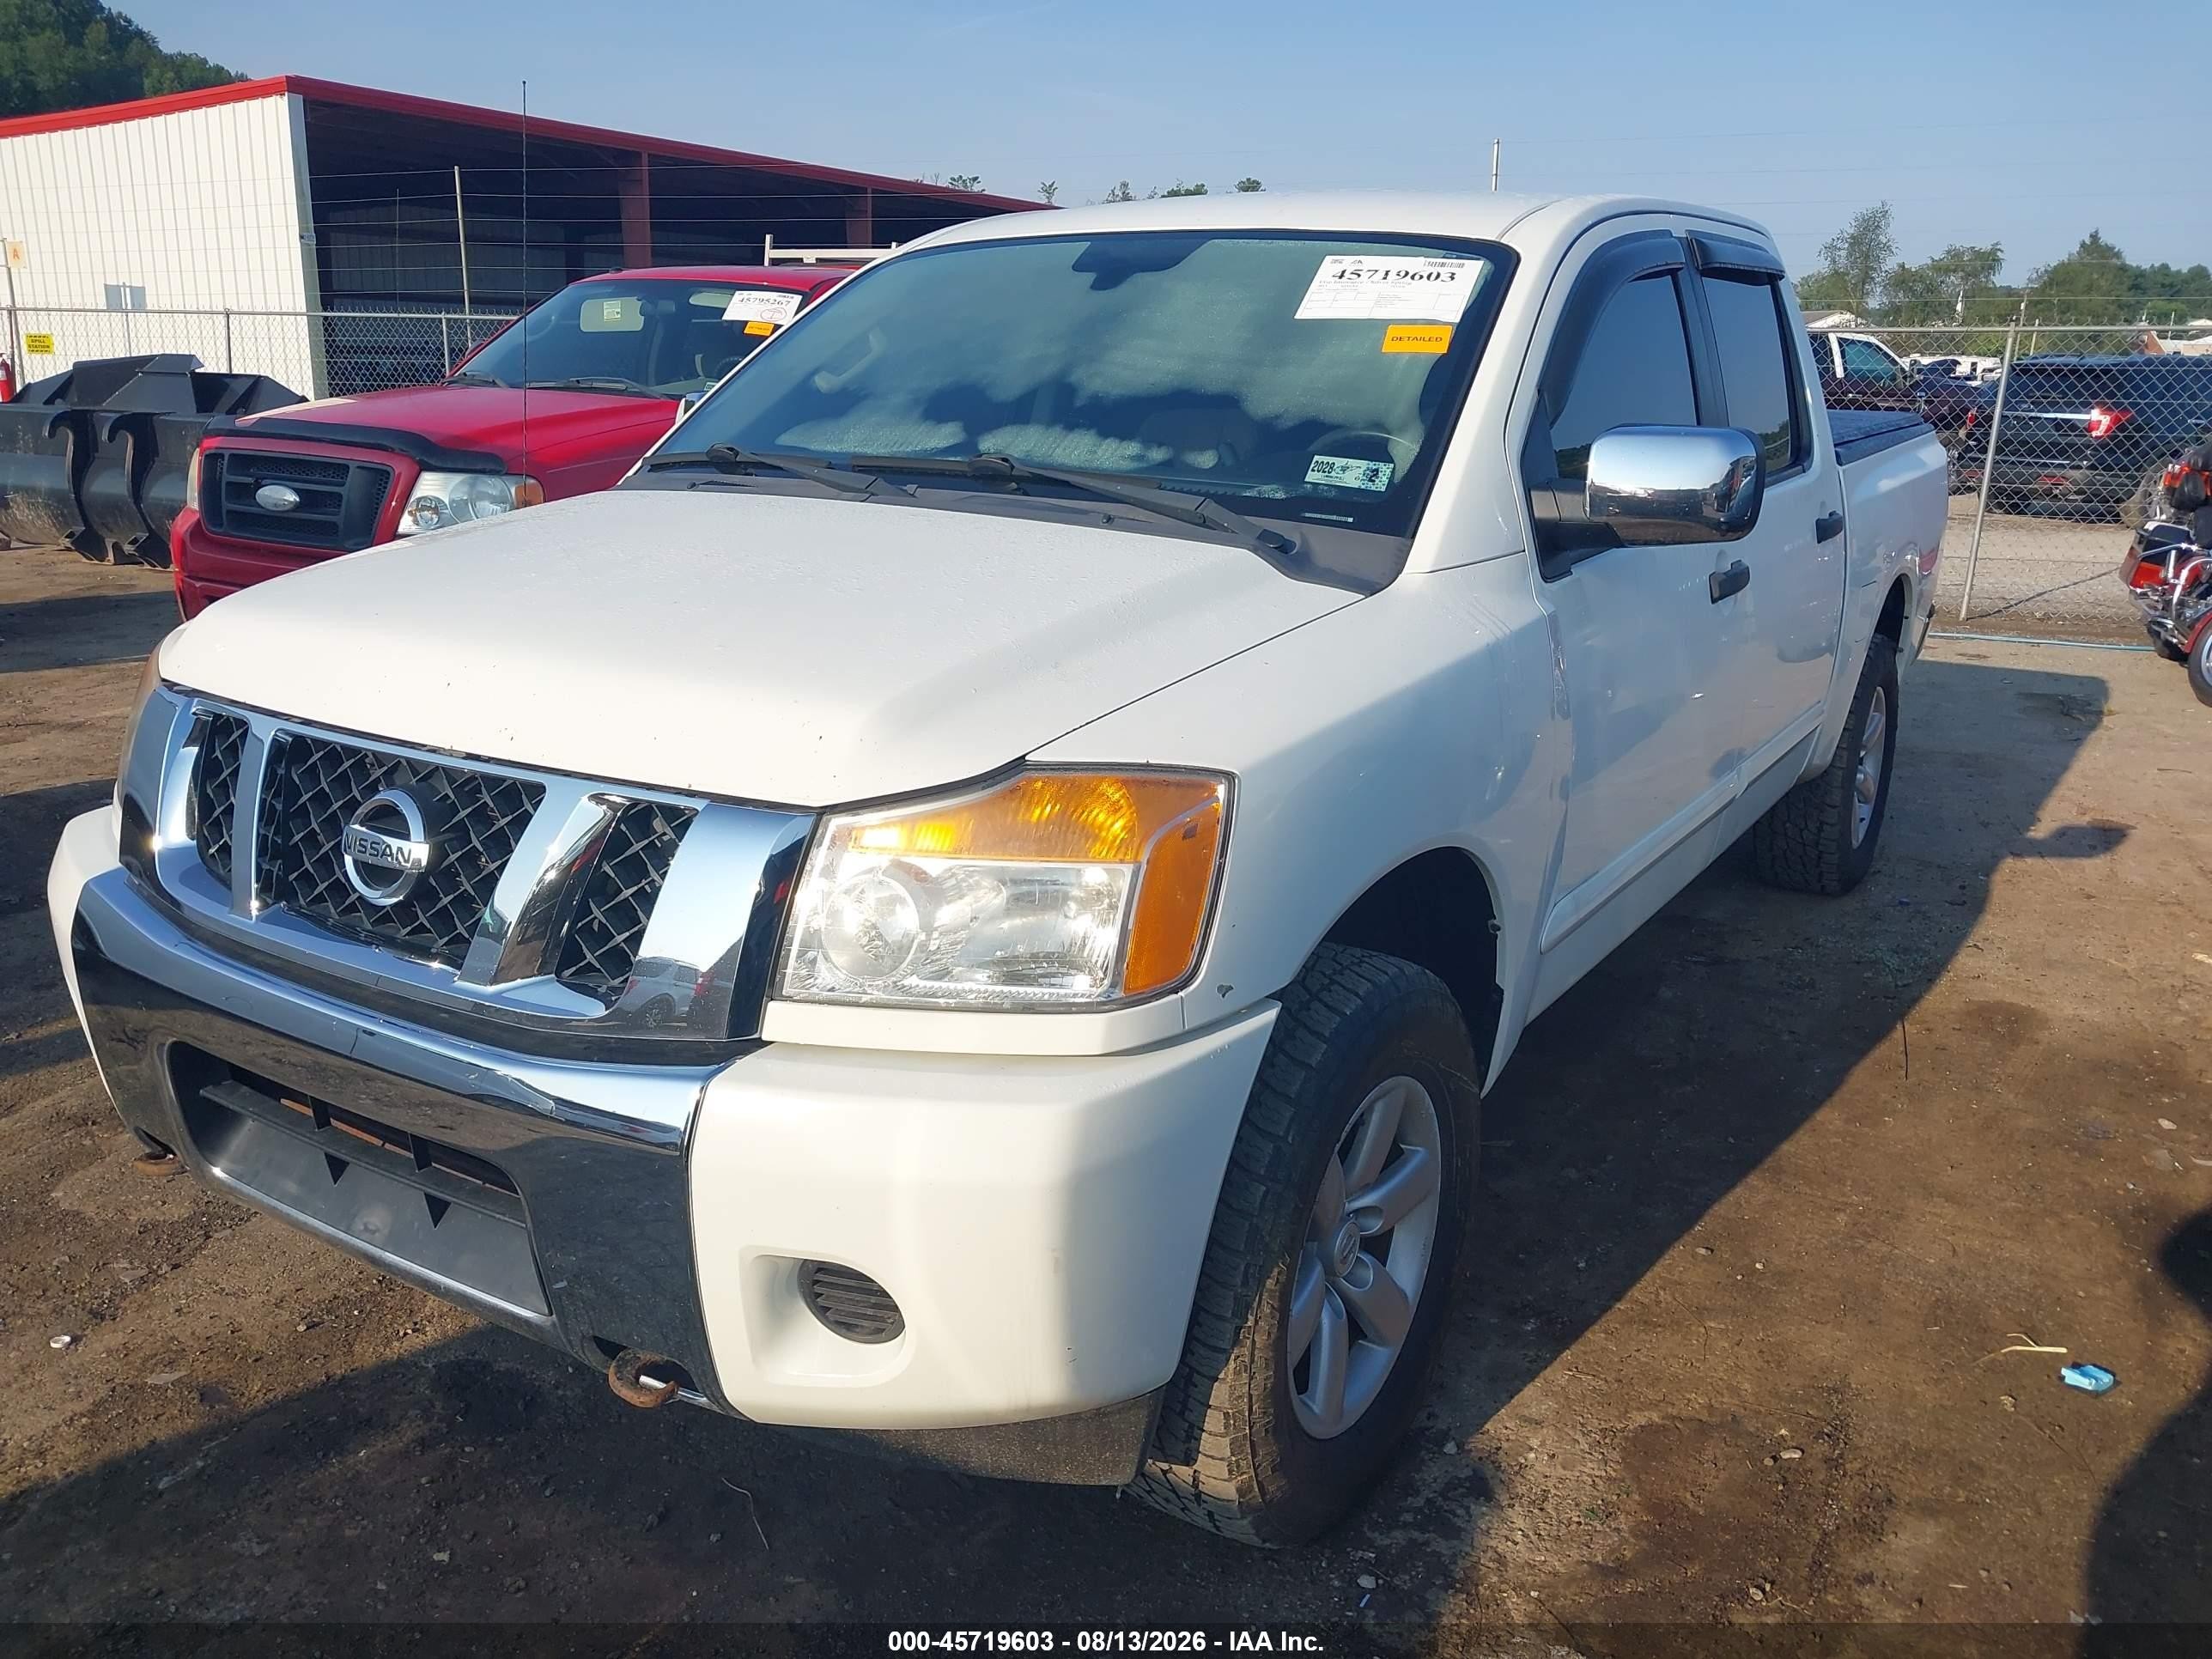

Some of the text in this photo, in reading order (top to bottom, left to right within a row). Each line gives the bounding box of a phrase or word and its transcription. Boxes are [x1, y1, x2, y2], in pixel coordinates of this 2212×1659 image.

[1332, 269, 1457, 283] 45719603
[738, 297, 791, 307] 45795267
[1310, 460, 1336, 474] 2028
[343, 831, 411, 866] NISSAN
